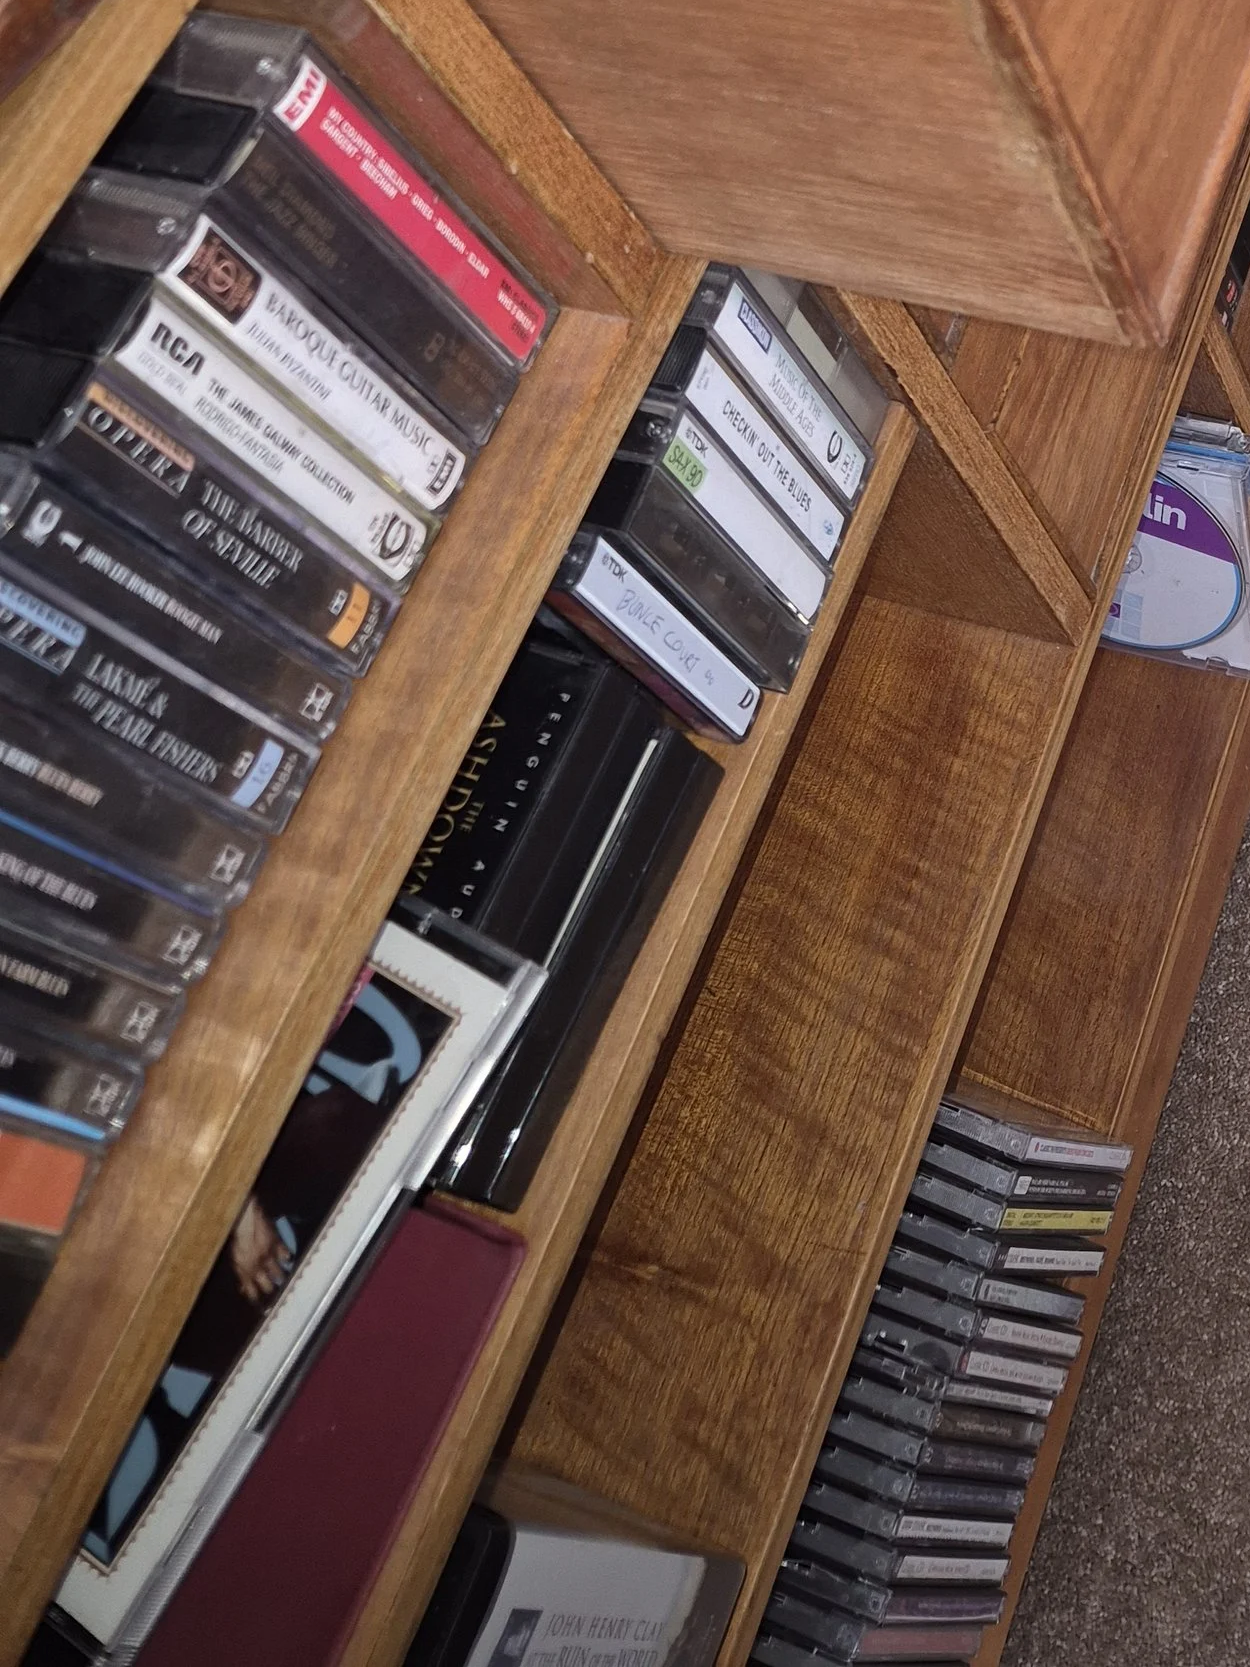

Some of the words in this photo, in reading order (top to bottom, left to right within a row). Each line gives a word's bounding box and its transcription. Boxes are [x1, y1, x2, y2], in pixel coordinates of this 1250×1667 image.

[285, 67, 322, 122] EMI
[319, 118, 360, 160] SARGENT
[359, 159, 398, 201] BEECHAM
[377, 156, 410, 197] SIBELIUS
[435, 217, 467, 256] BORODIN
[150, 321, 206, 377] RCA
[247, 322, 282, 360] JULIAN
[265, 291, 339, 368] BAROQUE
[338, 360, 394, 419] GUITAR
[390, 407, 437, 457] MUSIC
[768, 373, 797, 414] MIDDLE
[794, 408, 816, 439] AGES
[88, 406, 194, 494] OPERA
[208, 377, 229, 400] THE
[229, 397, 263, 431] JAMES
[263, 422, 301, 463] GALWAY
[298, 451, 356, 506] COLLECTION
[690, 431, 710, 459] TDK
[722, 399, 759, 447] CHECKIN'
[758, 442, 774, 463] OUT
[773, 459, 789, 485] THE
[787, 477, 813, 513] BLUES
[688, 467, 705, 488] 90
[181, 508, 218, 540] OF
[209, 529, 281, 590] SEVILLE
[609, 557, 628, 584] TDK
[737, 688, 755, 709] D
[492, 691, 572, 833] PENGUIN
[456, 800, 486, 835] THE
[542, 1613, 584, 1641] JOHN
[588, 1615, 629, 1640] HENRY
